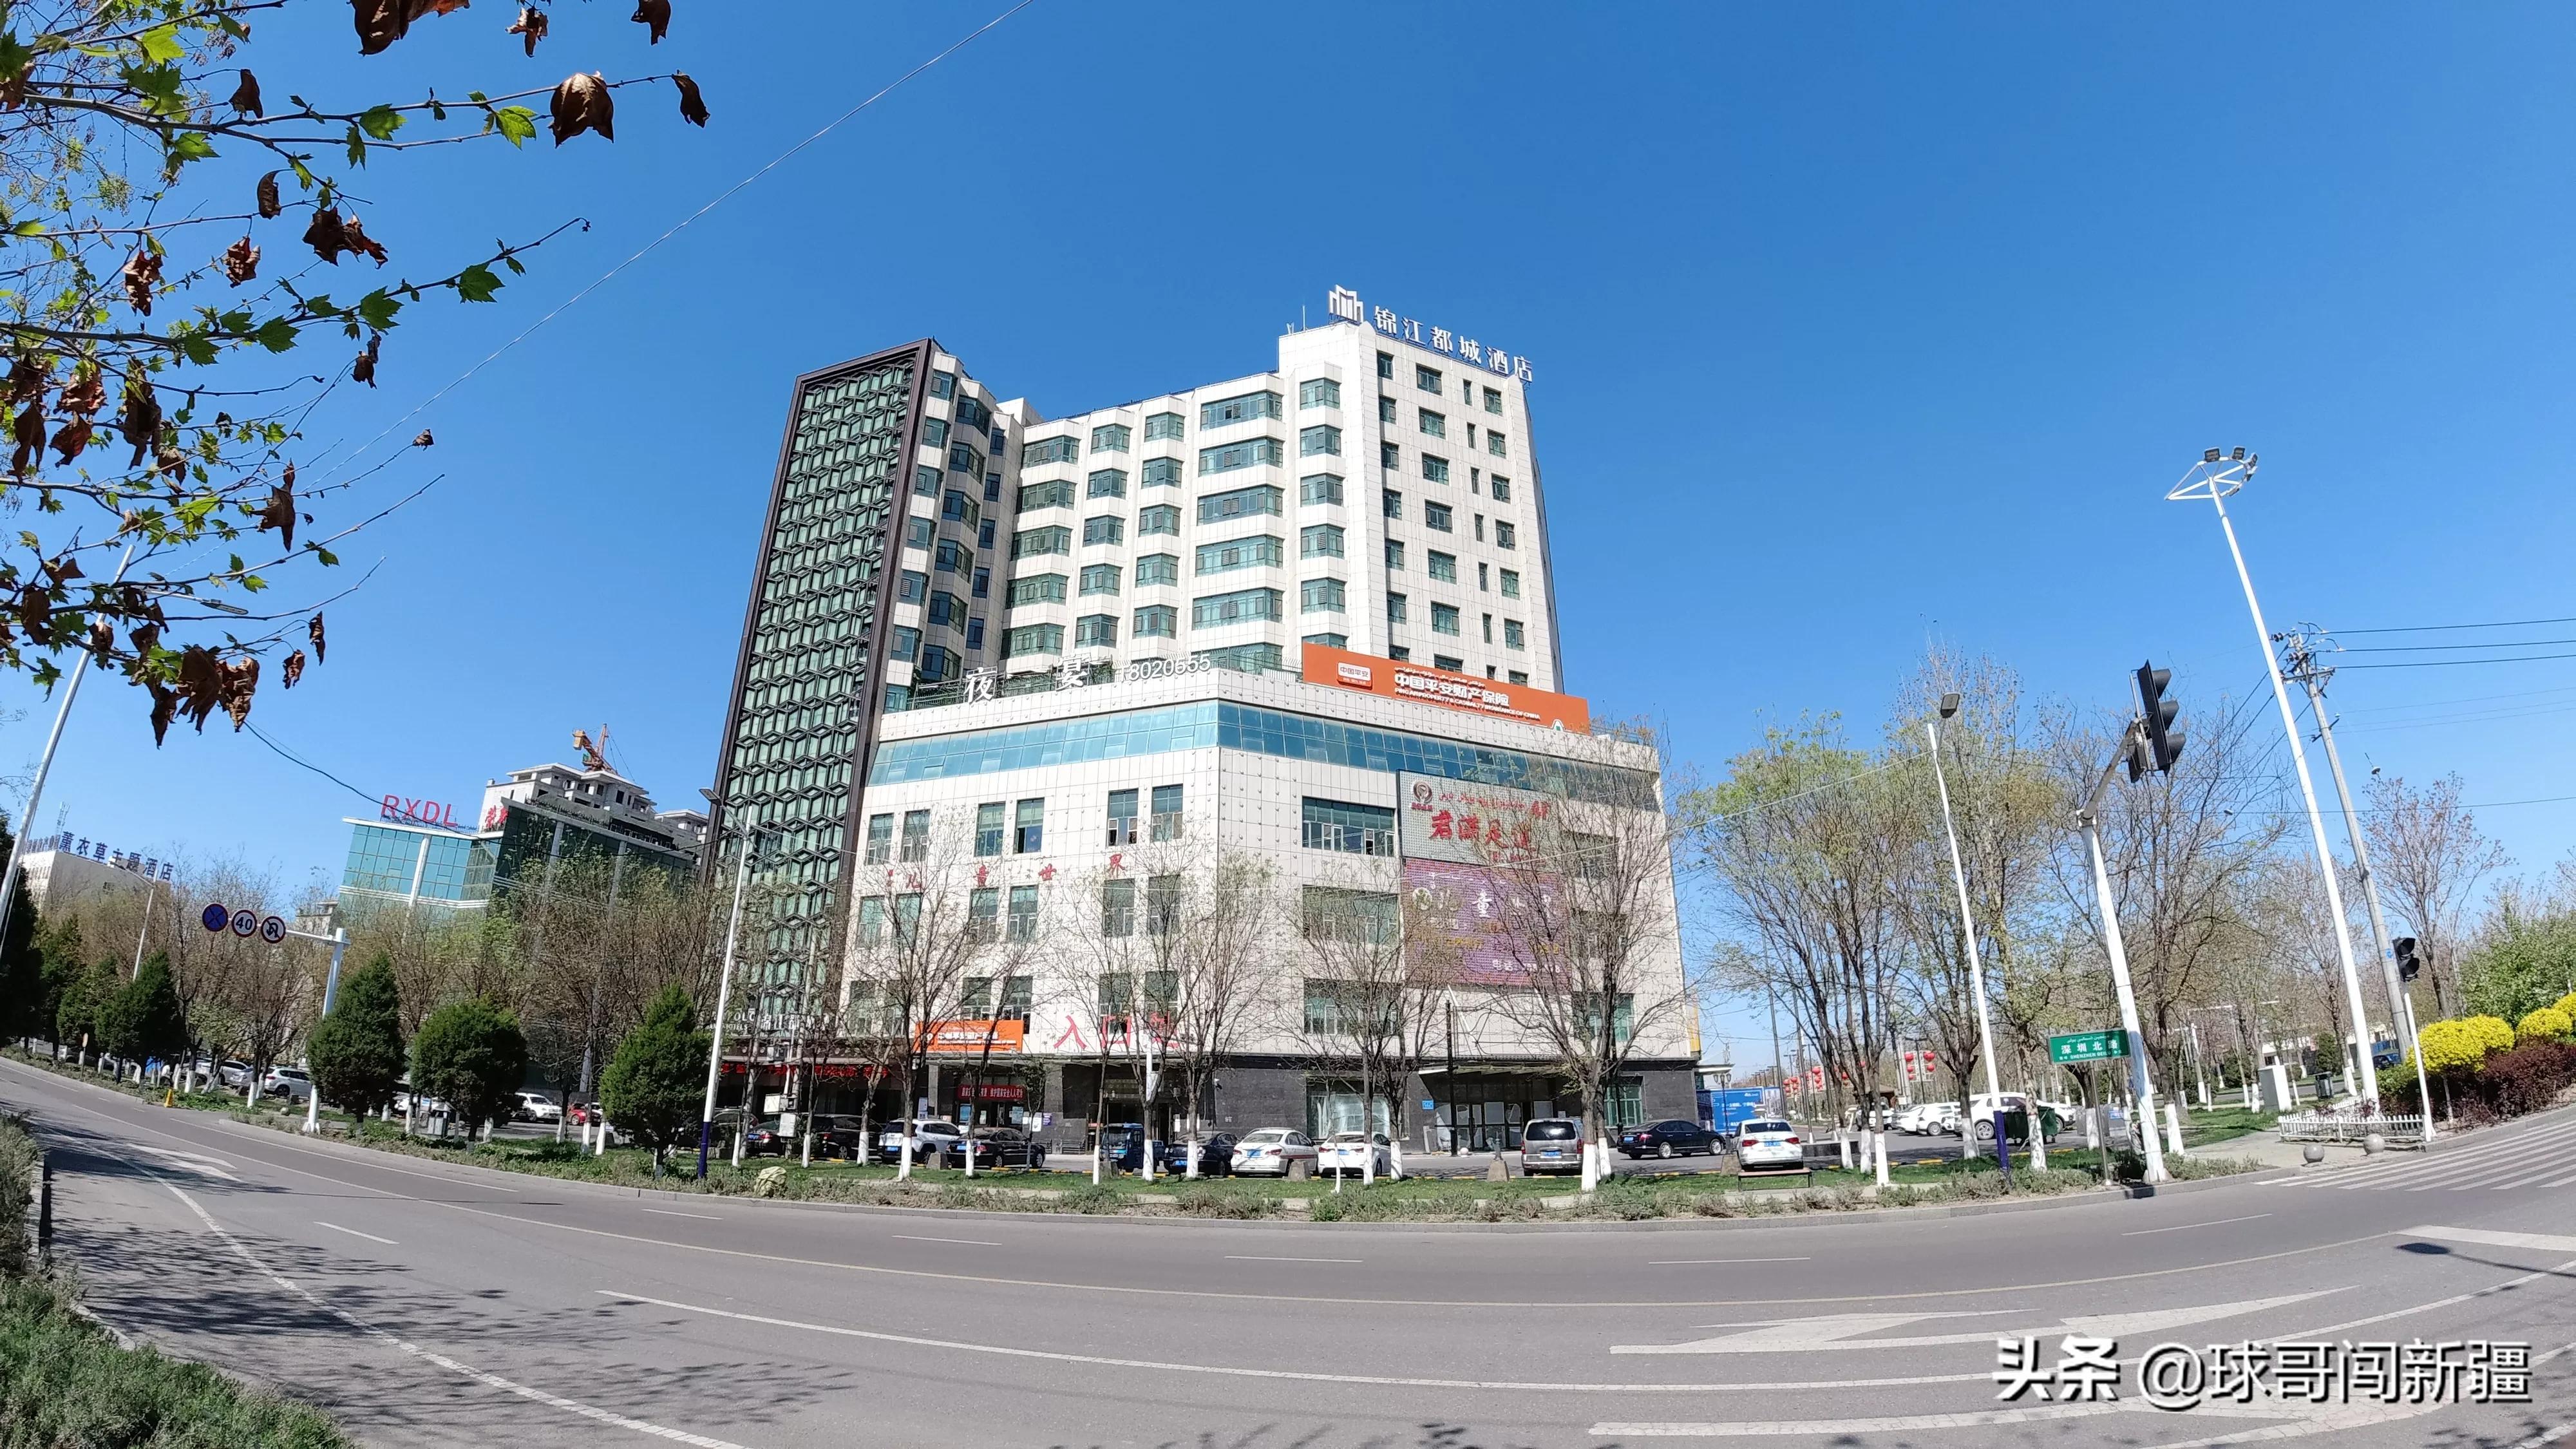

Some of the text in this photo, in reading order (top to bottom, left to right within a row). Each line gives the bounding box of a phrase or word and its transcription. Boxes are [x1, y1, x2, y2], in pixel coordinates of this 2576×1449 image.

[1374, 305, 1532, 383] 锦江都城酒店
[1340, 667, 1368, 677] 中国平安
[1395, 673, 1510, 707] 中国平安财产保险
[381, 794, 458, 828] RXDL
[59, 831, 174, 880] 薰衣草主题酒店
[235, 916, 253, 931] 40
[2061, 1039, 2118, 1054] 深圳北路
